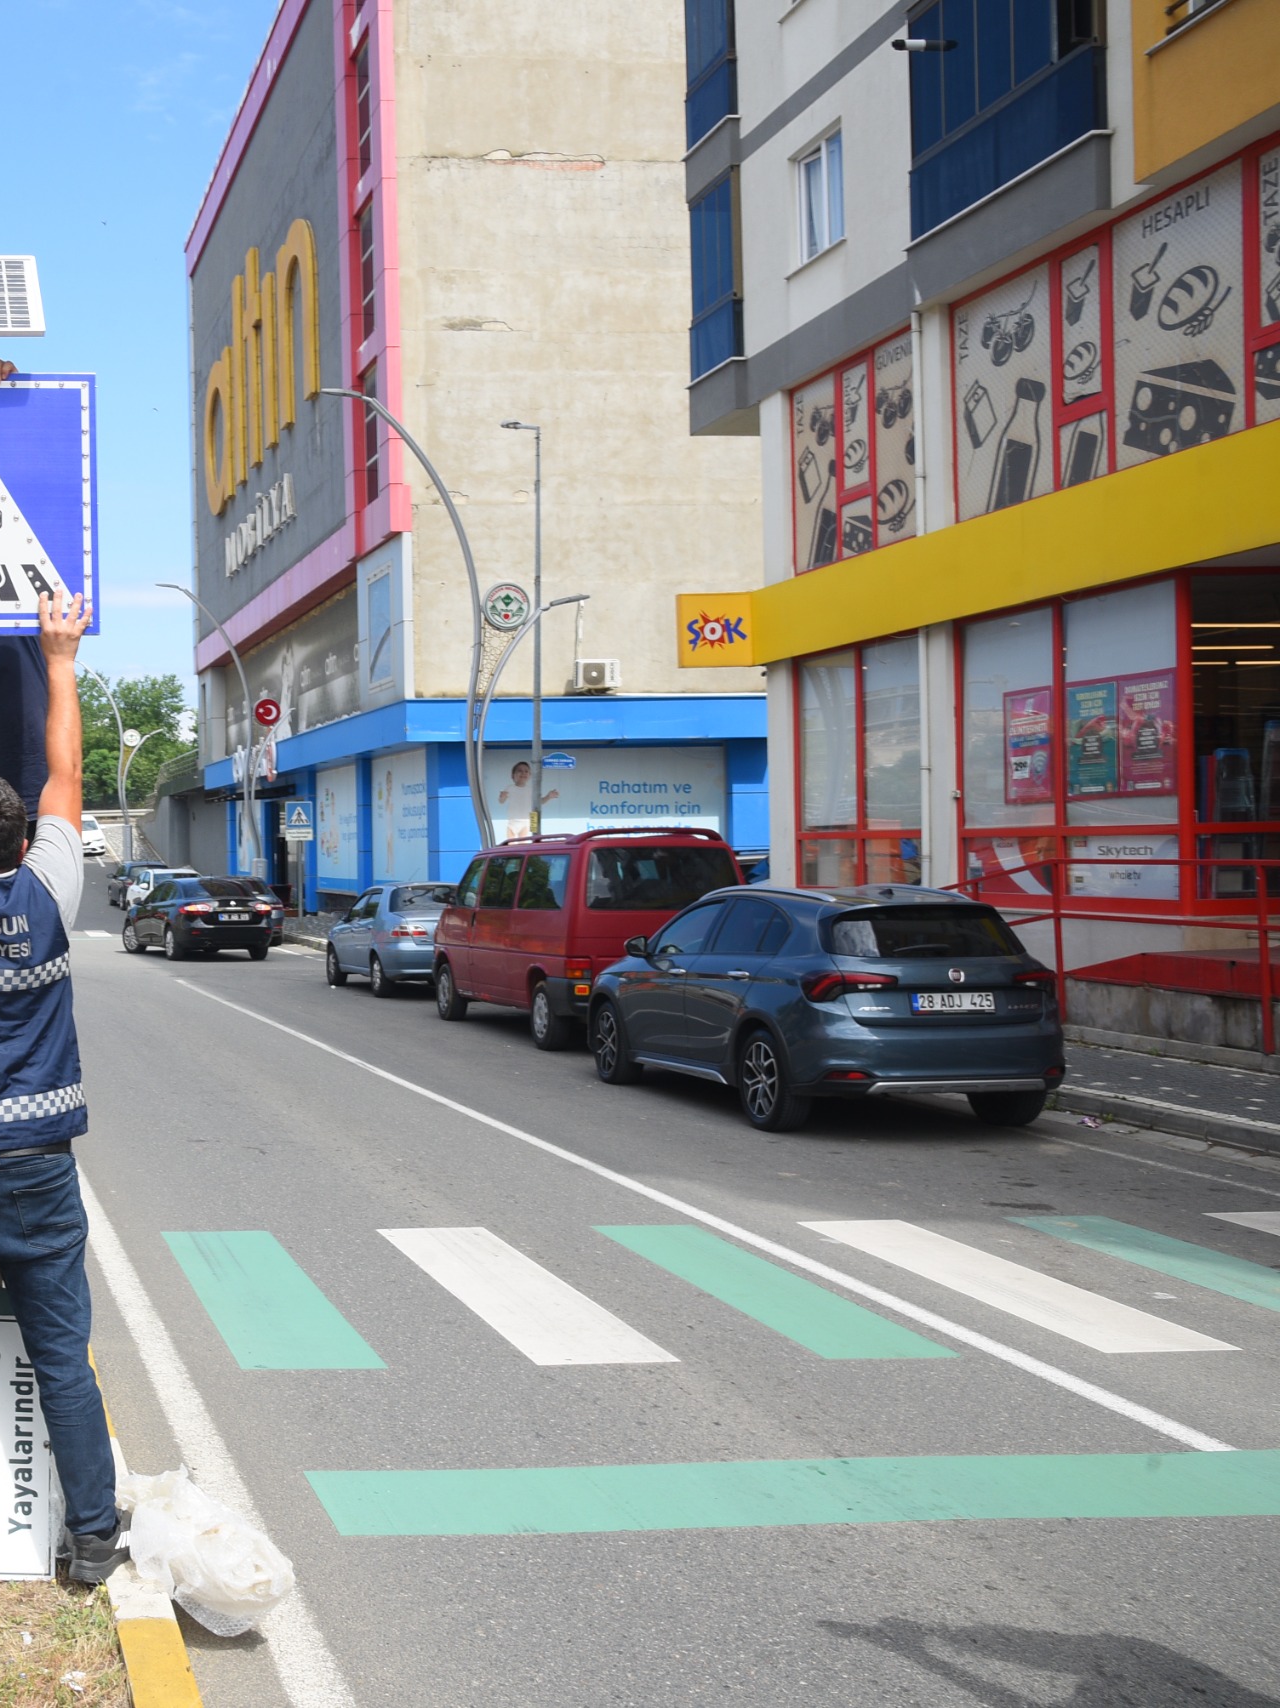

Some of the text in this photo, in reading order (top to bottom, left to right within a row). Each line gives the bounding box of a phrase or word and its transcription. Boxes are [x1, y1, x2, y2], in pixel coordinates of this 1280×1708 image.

[1263, 157, 1279, 226] TAZE
[1142, 186, 1210, 239] HESAPLI
[958, 312, 968, 365] TAZE
[687, 616, 748, 652] ŞOK
[599, 780, 692, 794] Rahatım ve
[590, 801, 701, 817] konforum için
[1097, 844, 1153, 857] Skytech
[920, 995, 935, 1009] 28
[940, 994, 963, 1008] ADJ
[970, 993, 993, 1008] 425
[8, 1356, 38, 1535] Yayalarındır
